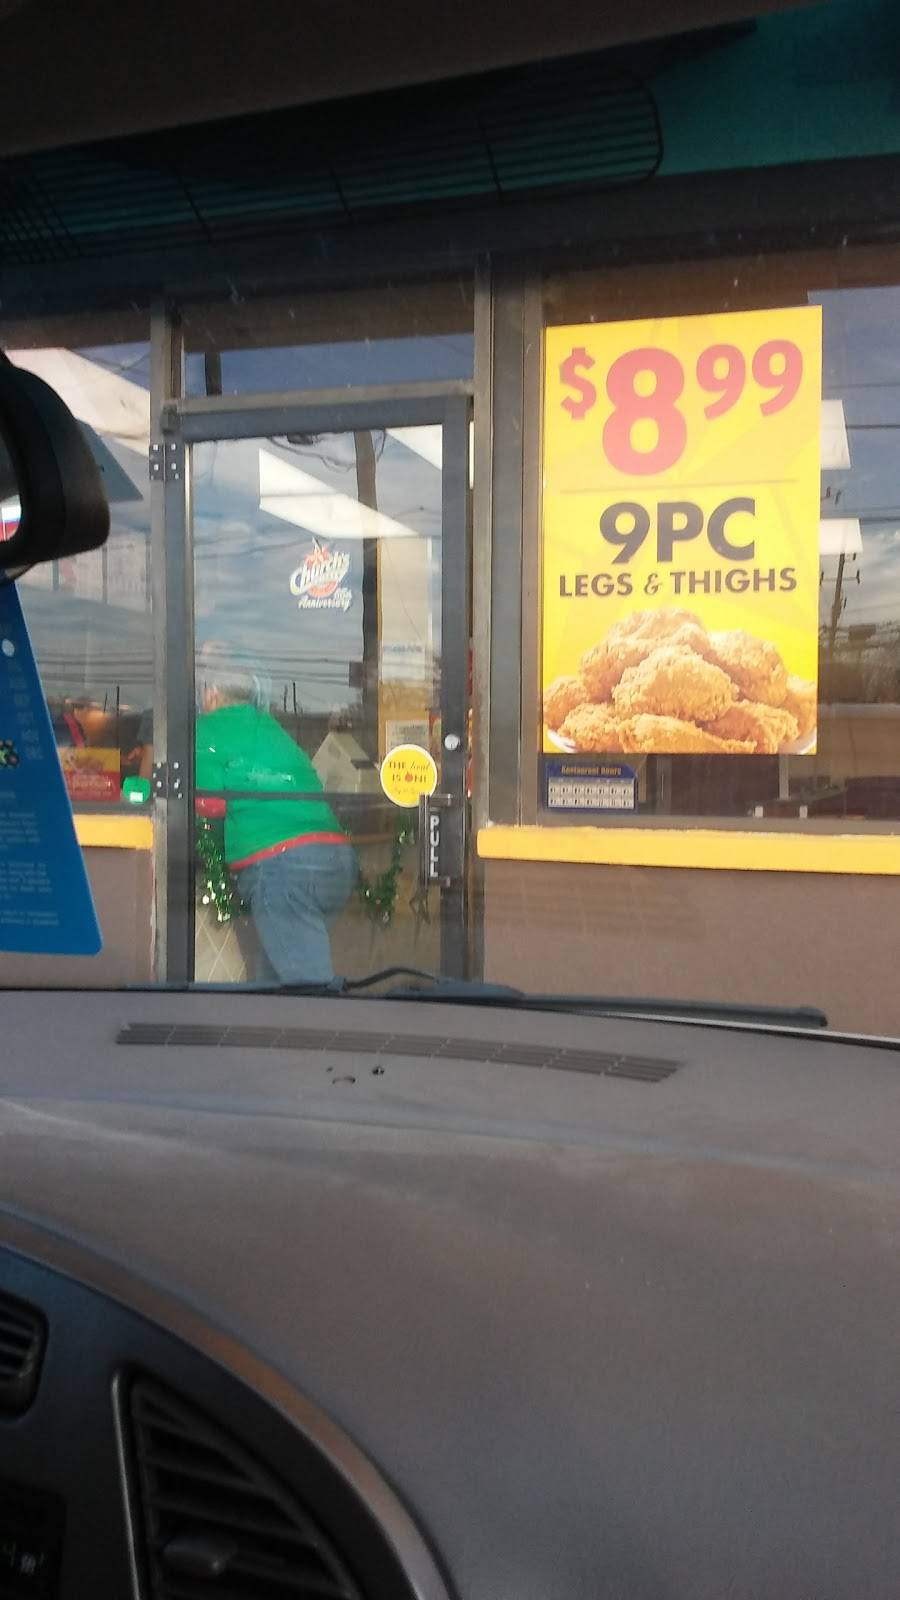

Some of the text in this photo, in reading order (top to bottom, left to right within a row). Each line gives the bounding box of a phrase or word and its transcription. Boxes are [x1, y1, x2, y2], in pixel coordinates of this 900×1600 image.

[600, 497, 755, 565] 9PC
[559, 568, 797, 598] LEGS & THIGHS
[430, 814, 440, 878] PULL
